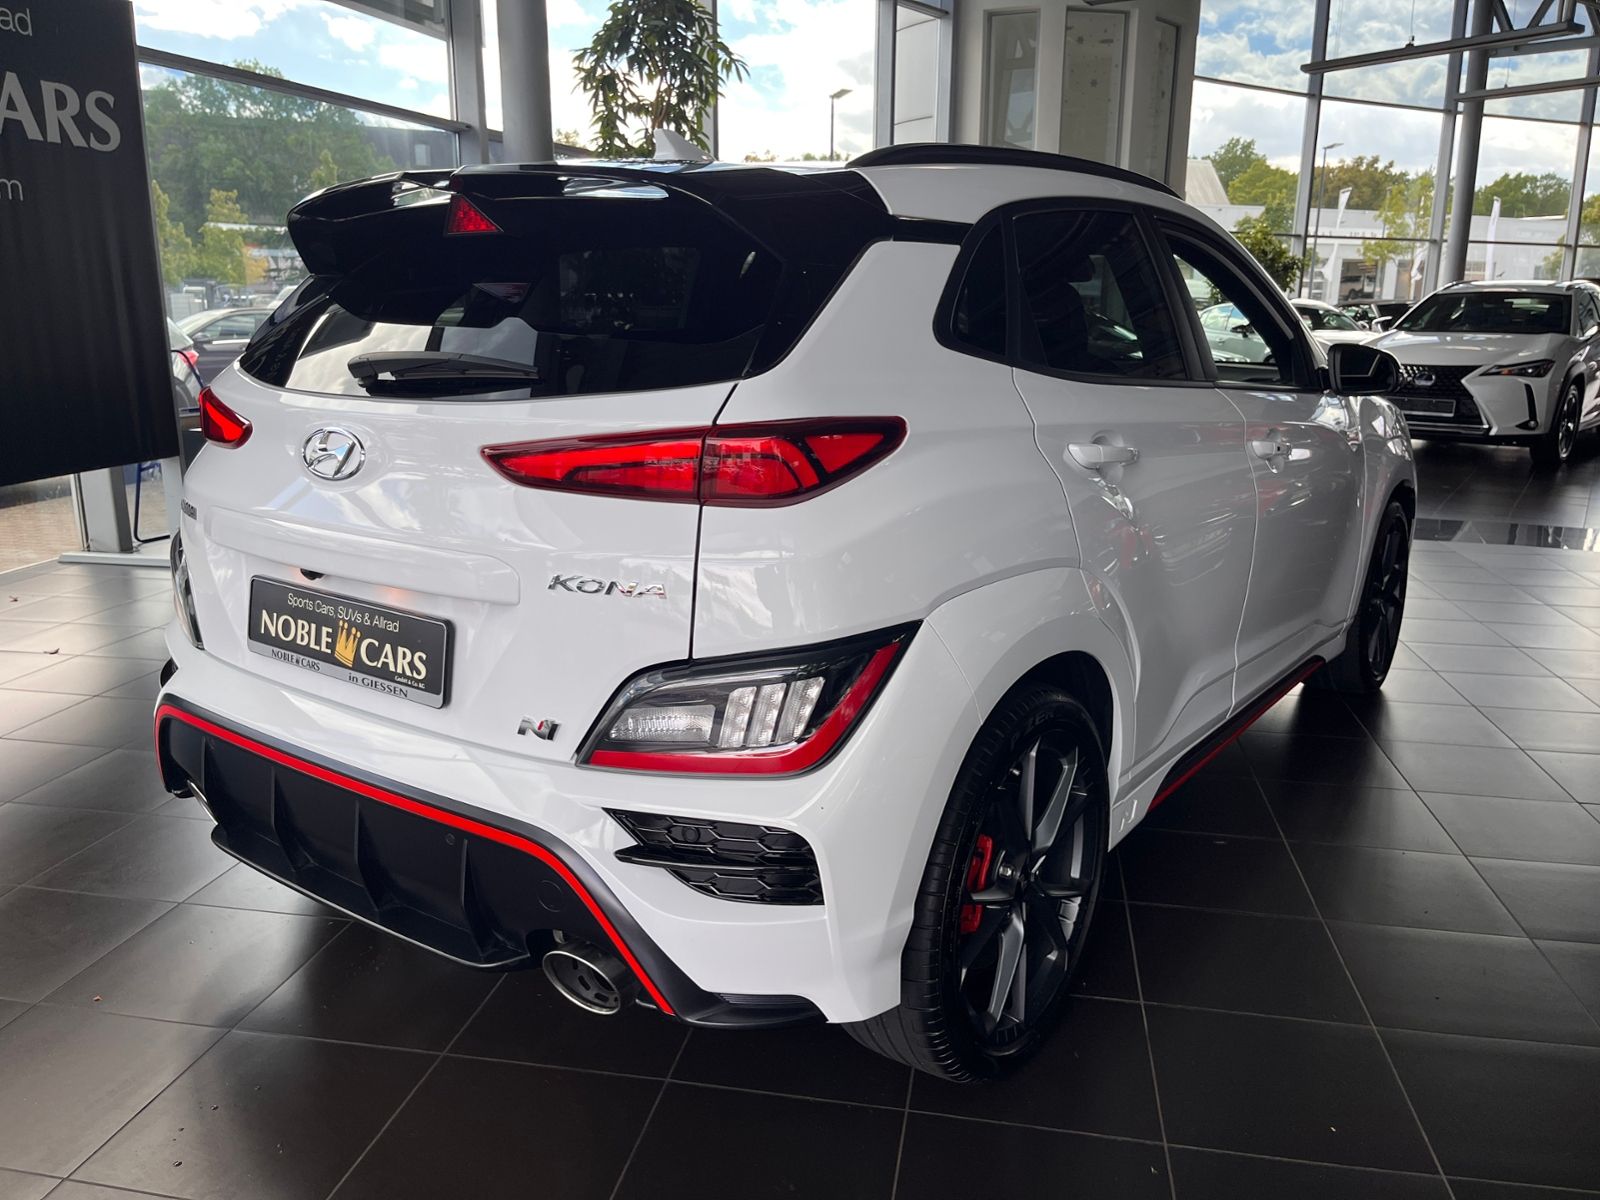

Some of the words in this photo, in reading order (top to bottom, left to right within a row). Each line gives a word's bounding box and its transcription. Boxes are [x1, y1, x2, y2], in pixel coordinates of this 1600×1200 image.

[547, 574, 667, 599] KONA
[287, 593, 314, 611] Sports
[314, 600, 336, 617] Cars,
[337, 605, 362, 623] SUVs
[364, 613, 371, 626] &
[372, 614, 400, 633] Allrad
[260, 609, 333, 653] NOBLE
[360, 638, 427, 680] CARS
[271, 649, 295, 664] NOBLE
[301, 657, 321, 671] CARS
[348, 672, 358, 682] in
[361, 676, 408, 698] GIESSEN
[517, 717, 561, 741] N
